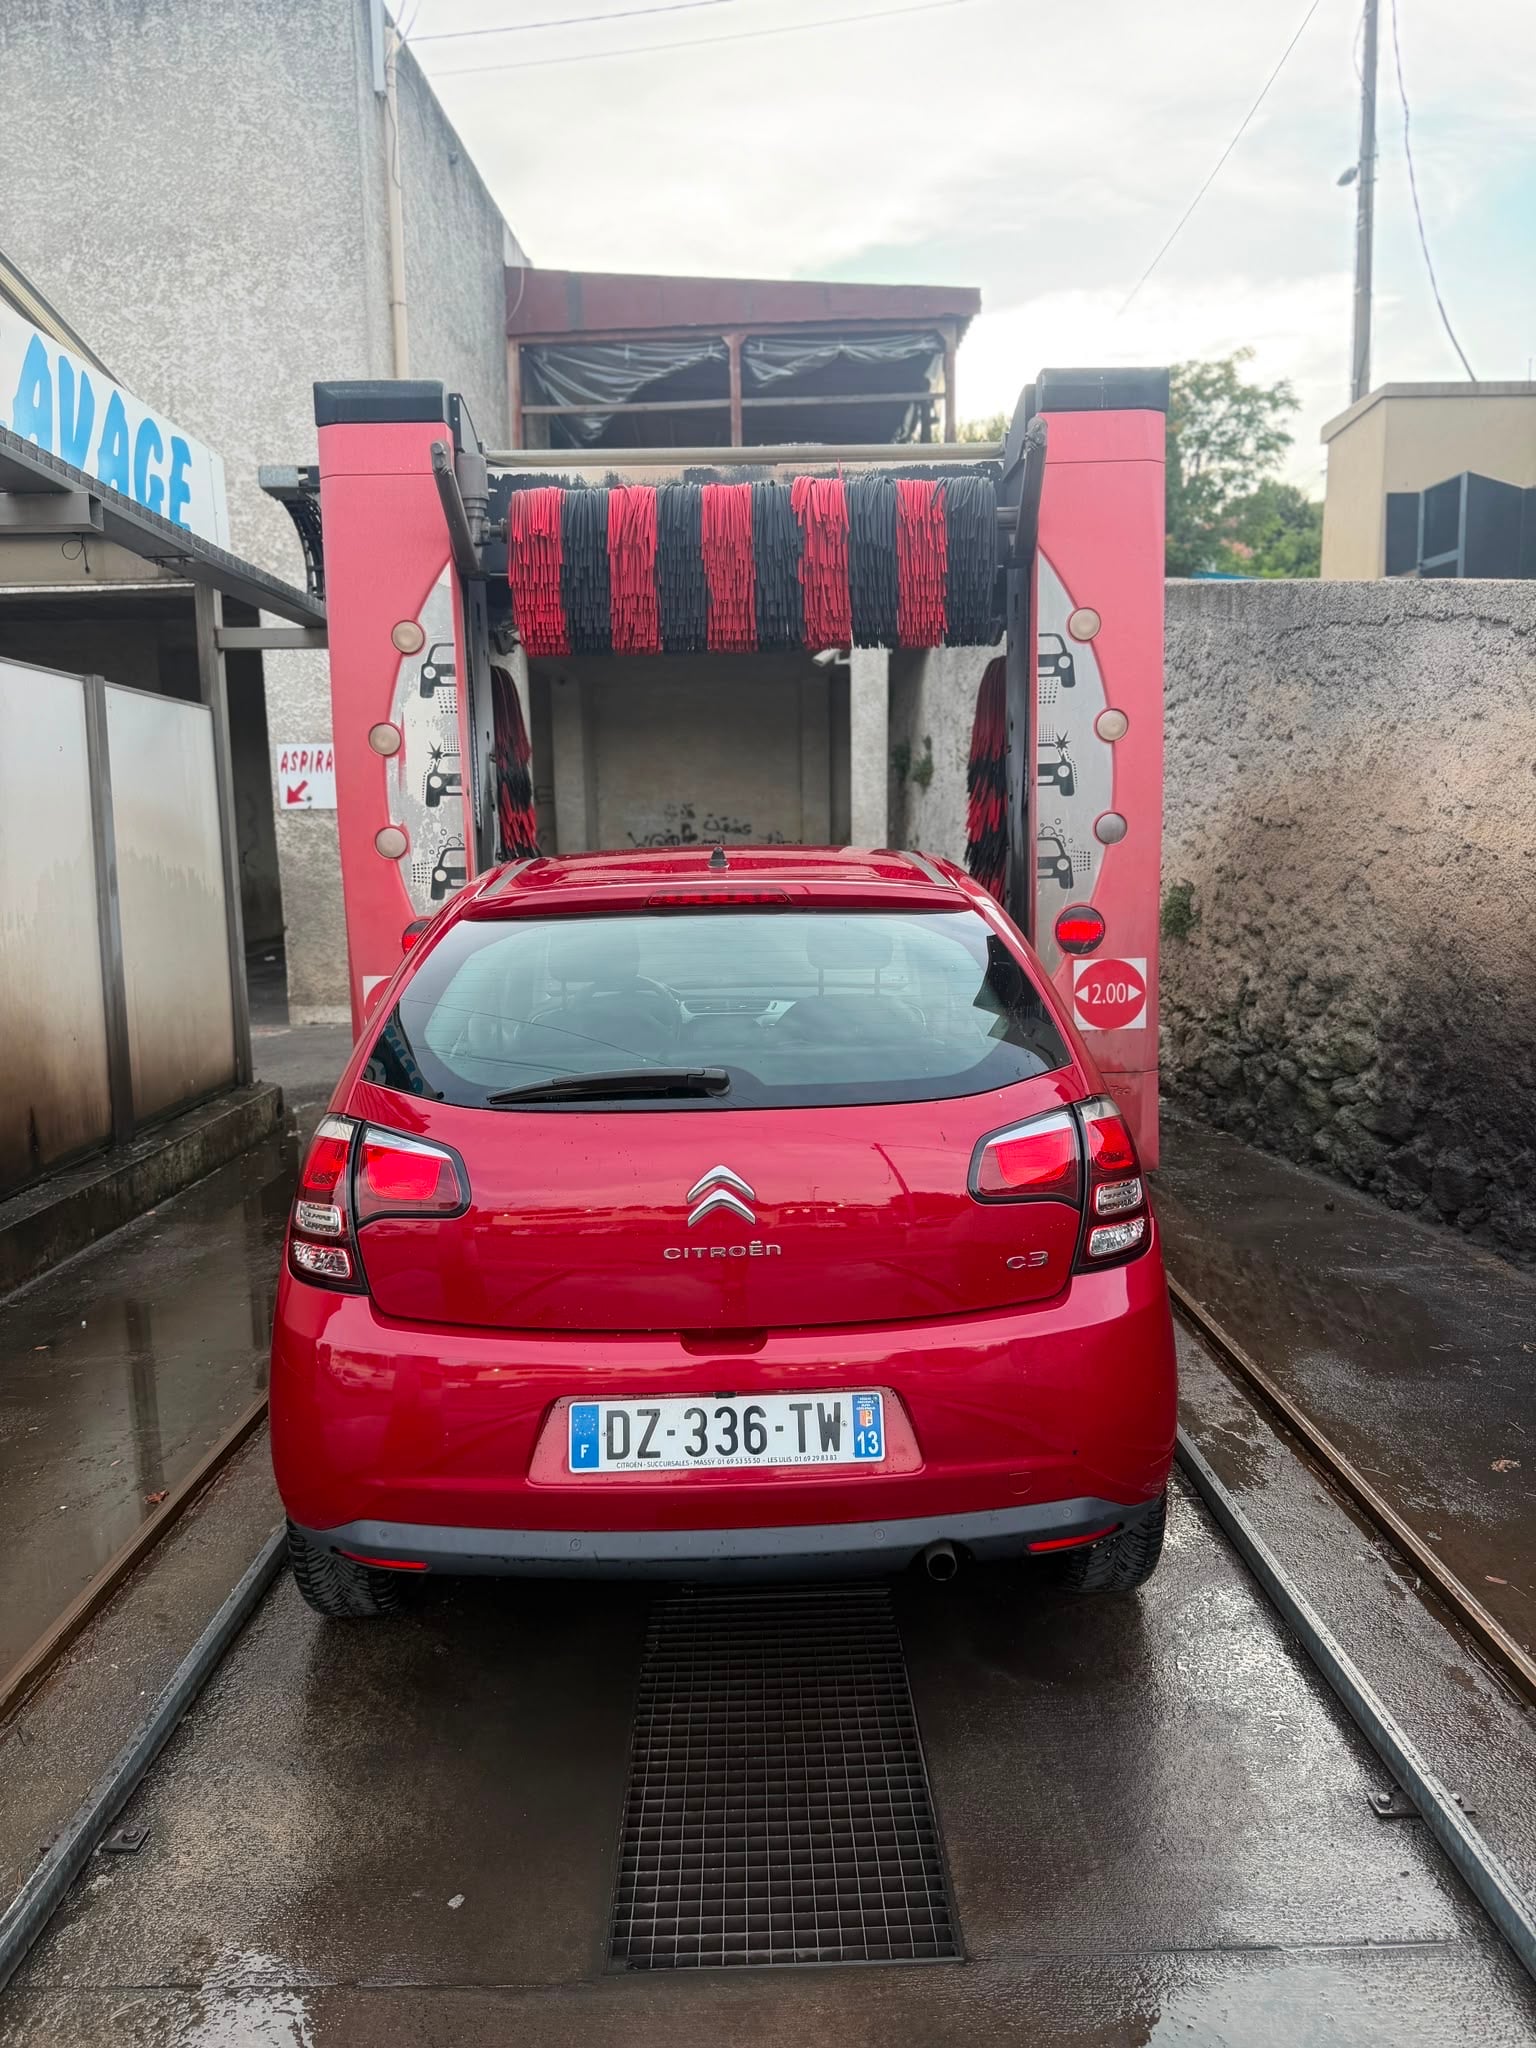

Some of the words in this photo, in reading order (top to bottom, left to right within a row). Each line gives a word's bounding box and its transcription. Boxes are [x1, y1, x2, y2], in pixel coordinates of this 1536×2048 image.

[0, 333, 192, 531] AVAGE
[281, 750, 333, 774] ASPIRA
[1092, 983, 1126, 1004] 2.00
[1006, 1251, 1048, 1269] C3
[606, 1402, 841, 1460] DZ-336-TW
[857, 1430, 879, 1455] 13
[580, 1444, 589, 1458] F
